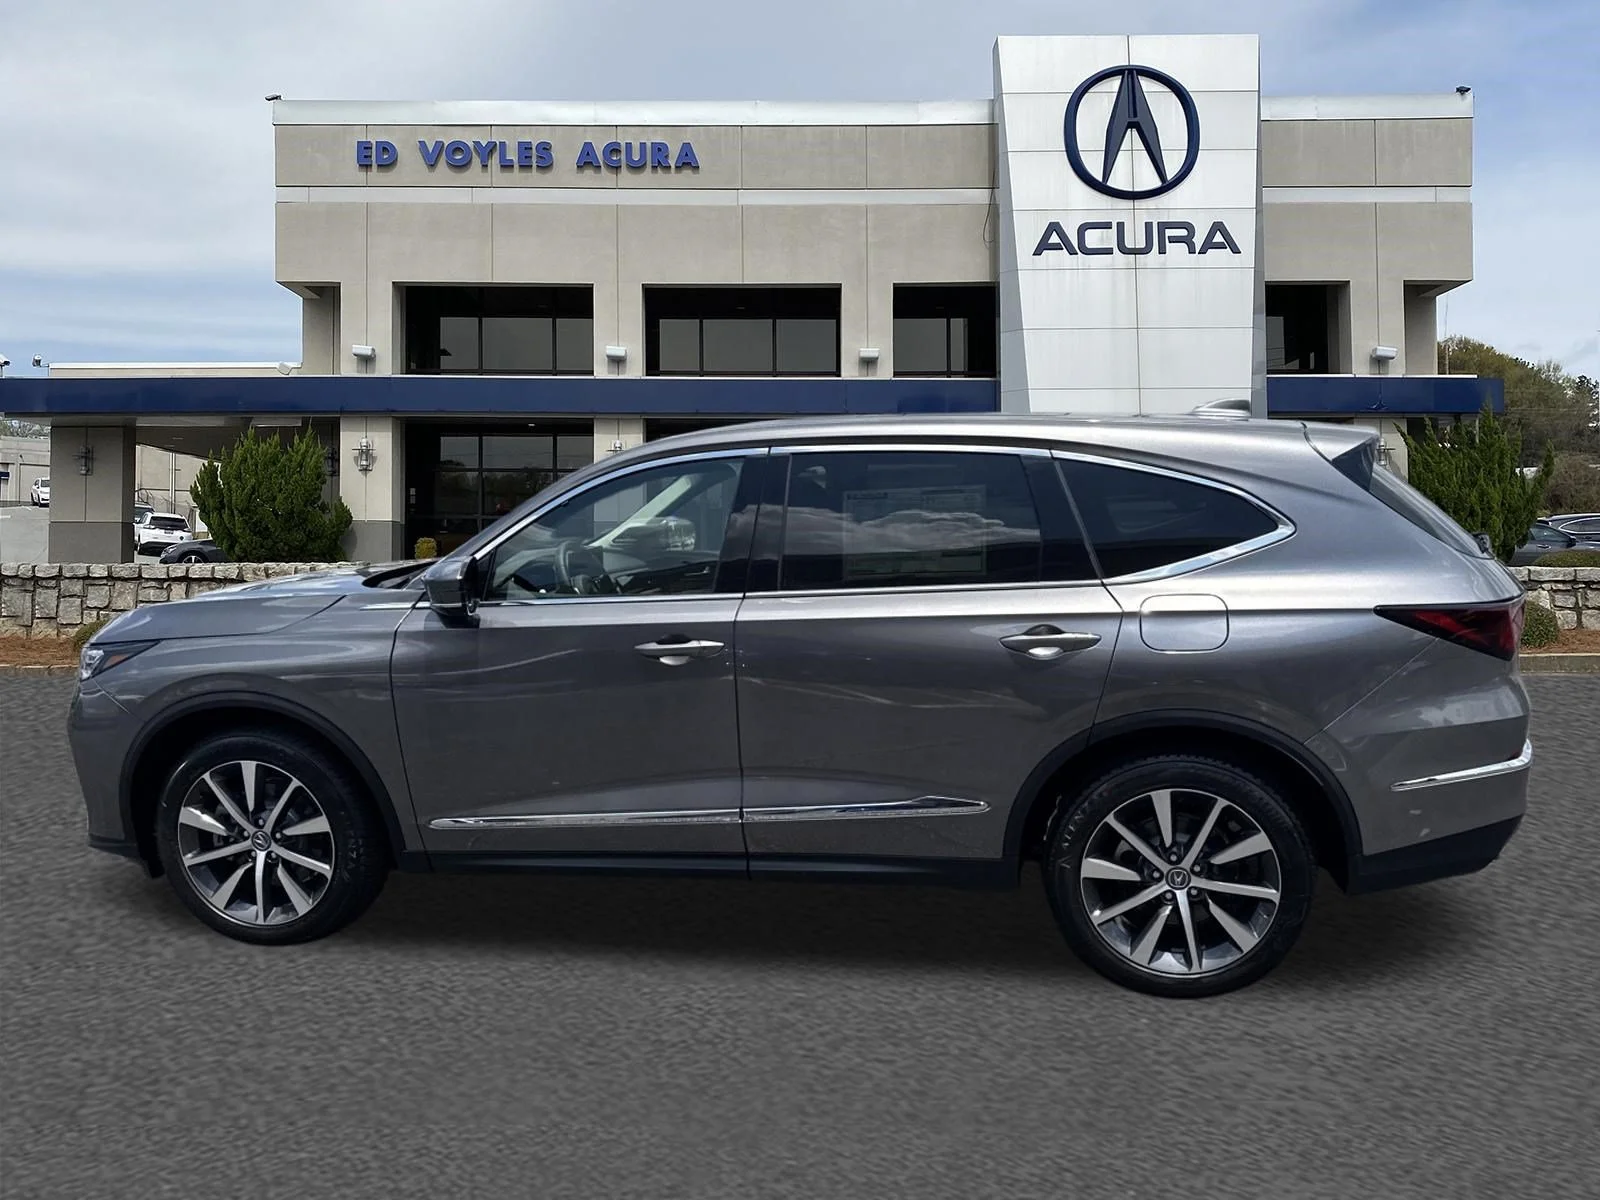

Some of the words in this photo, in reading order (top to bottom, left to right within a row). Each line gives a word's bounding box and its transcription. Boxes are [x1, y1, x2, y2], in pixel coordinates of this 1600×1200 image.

[356, 140, 398, 167] ED
[417, 140, 554, 169] VOYLES
[576, 140, 700, 168] ACURA
[1032, 221, 1242, 256] ACURA
